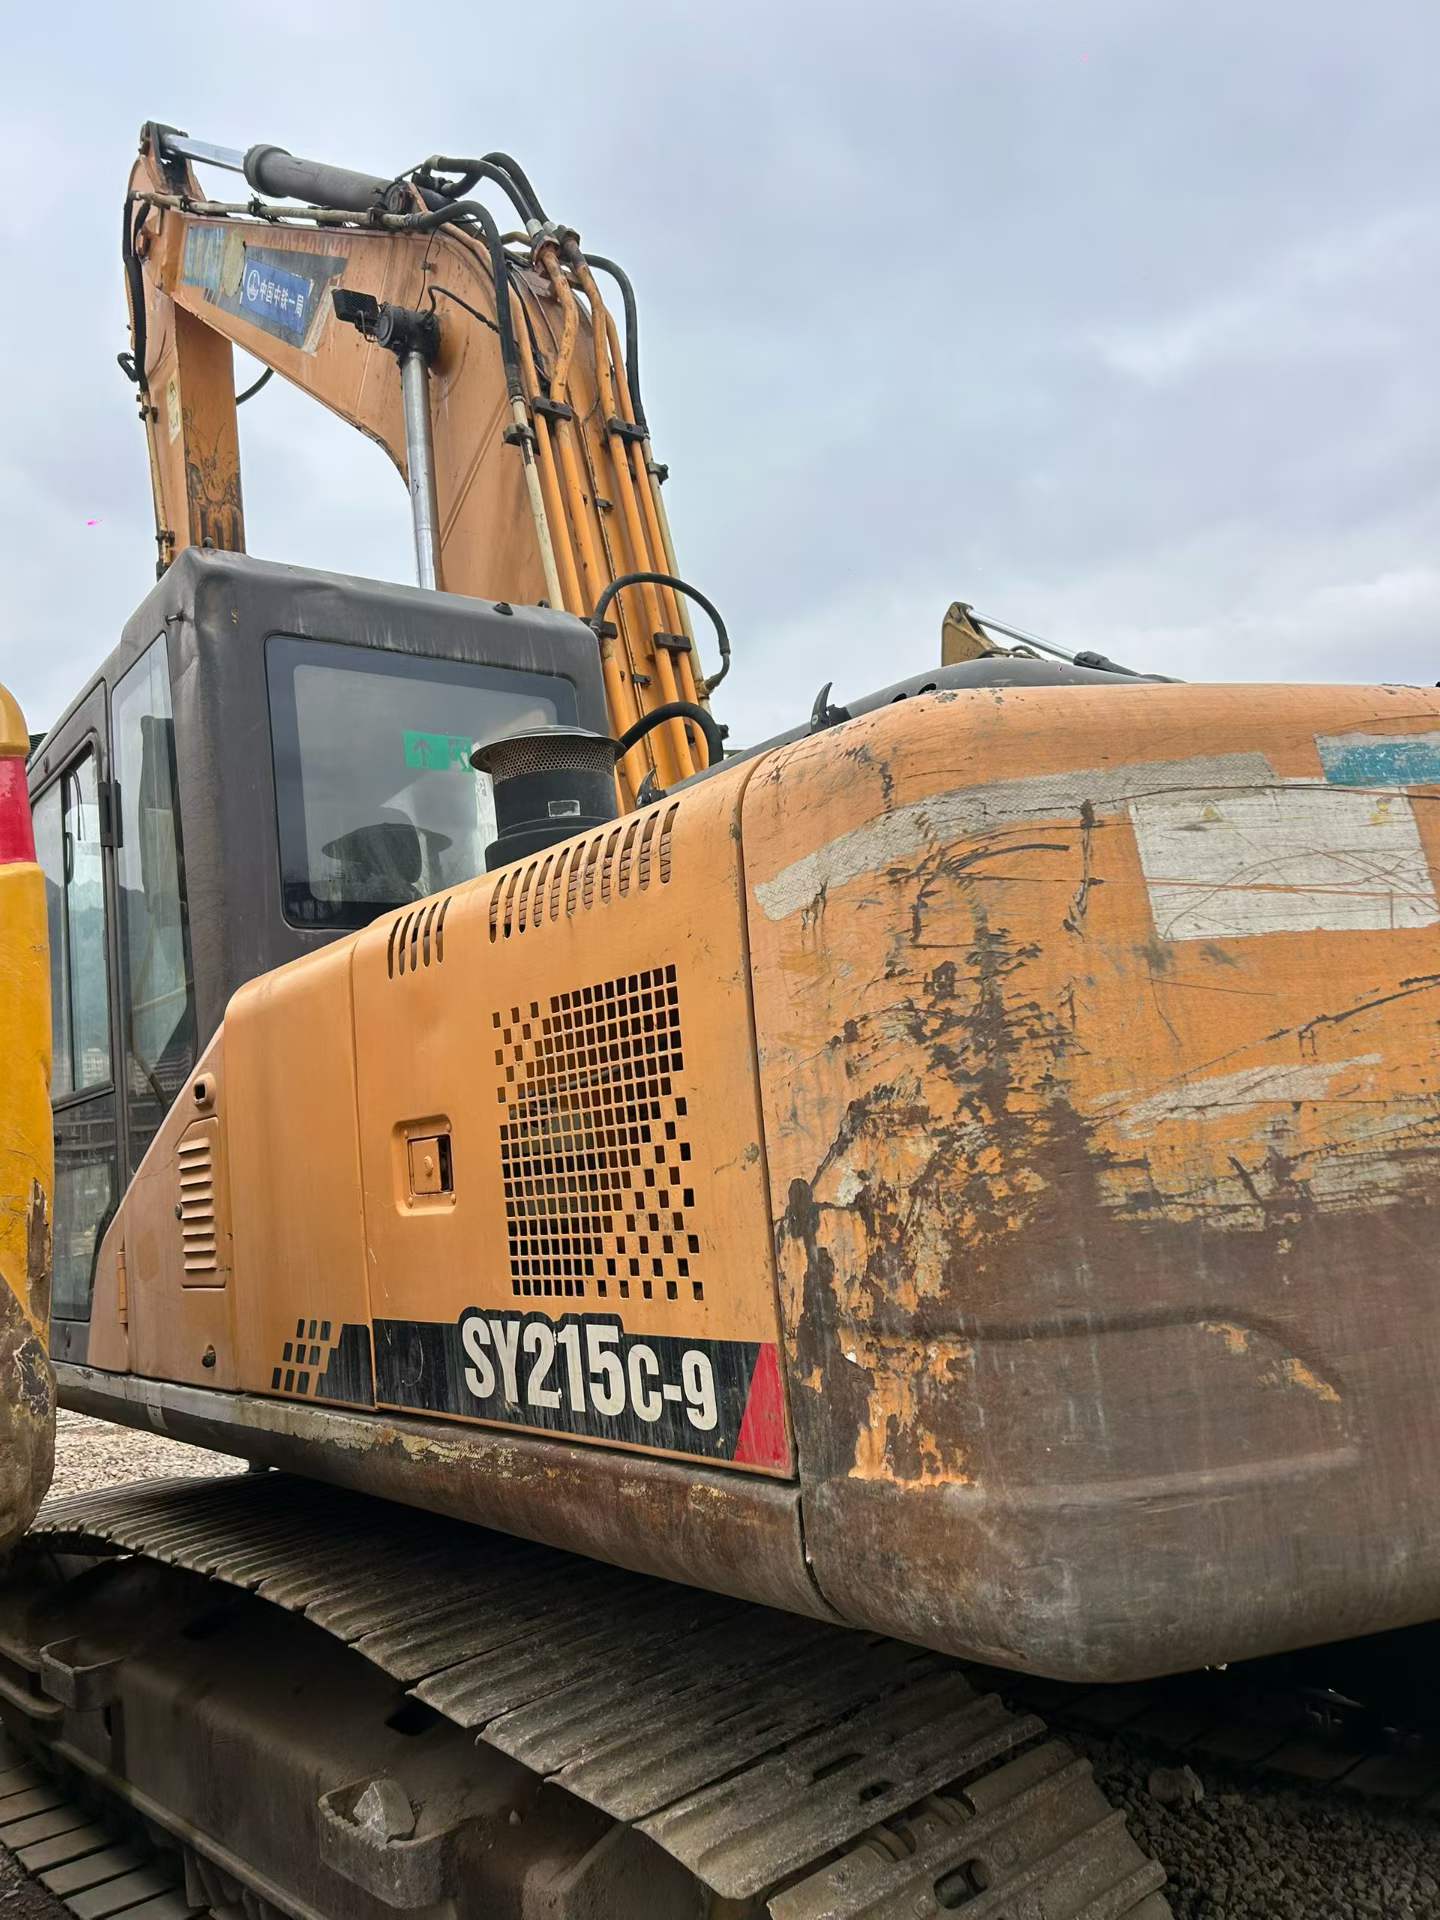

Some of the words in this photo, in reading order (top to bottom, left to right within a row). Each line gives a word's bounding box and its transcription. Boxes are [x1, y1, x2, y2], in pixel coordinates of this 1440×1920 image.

[259, 279, 304, 319] 中国中铁一局
[461, 1316, 719, 1431] SY215C-9
